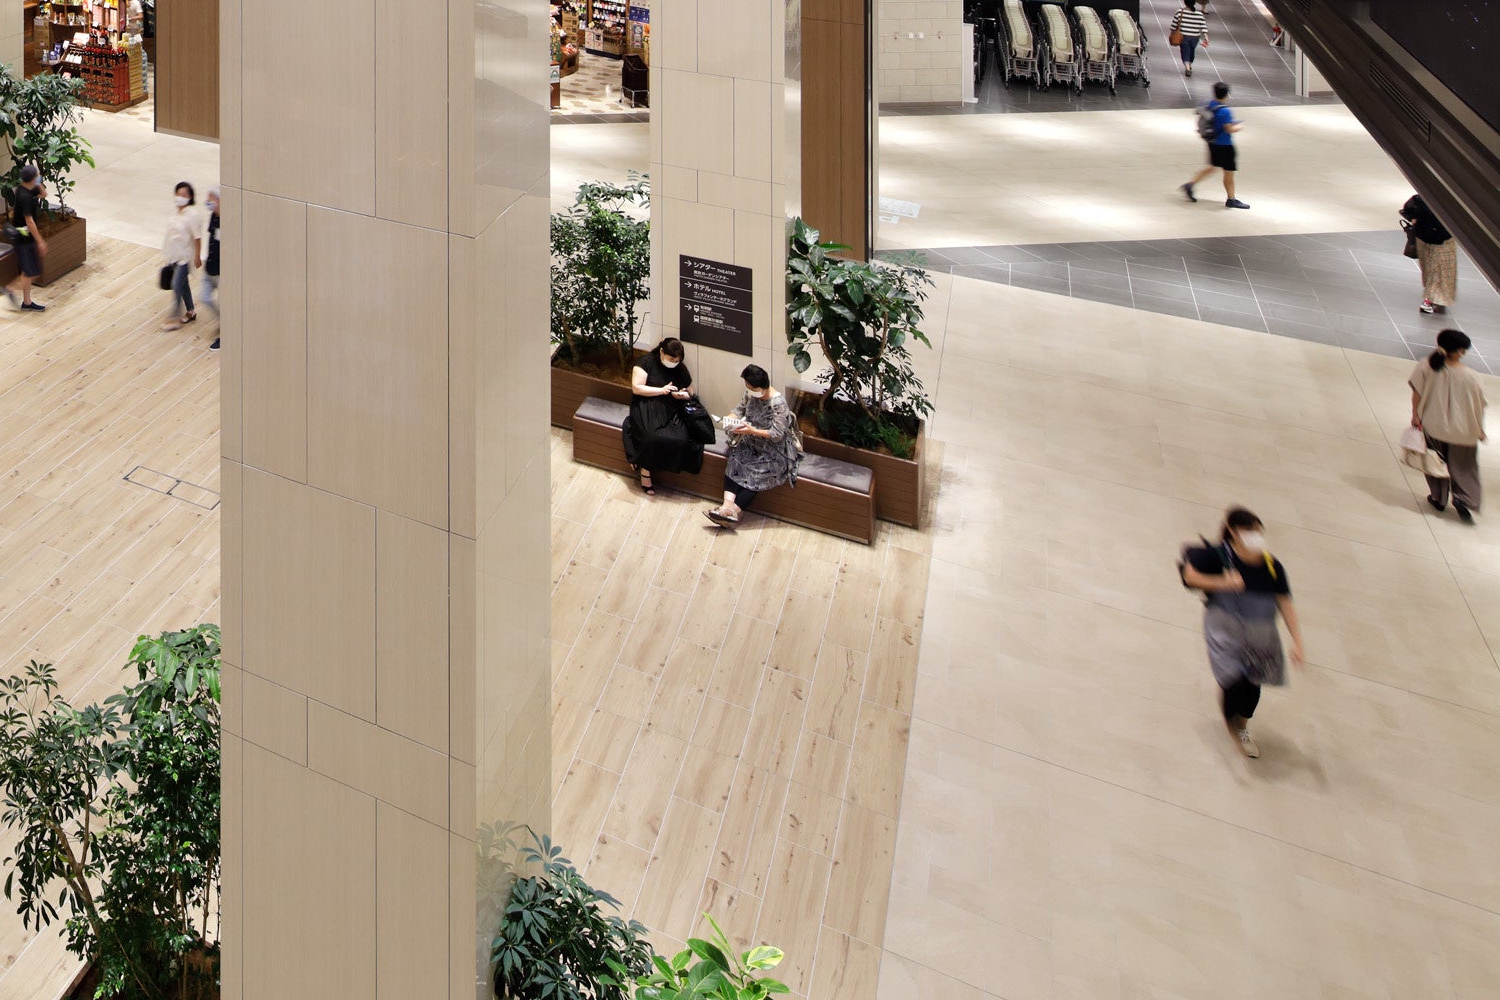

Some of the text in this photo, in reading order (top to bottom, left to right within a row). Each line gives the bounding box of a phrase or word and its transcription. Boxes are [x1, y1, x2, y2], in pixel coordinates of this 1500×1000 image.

[693, 261, 737, 276] シアター THEATER
[693, 283, 727, 296] ホテル HOTEL
